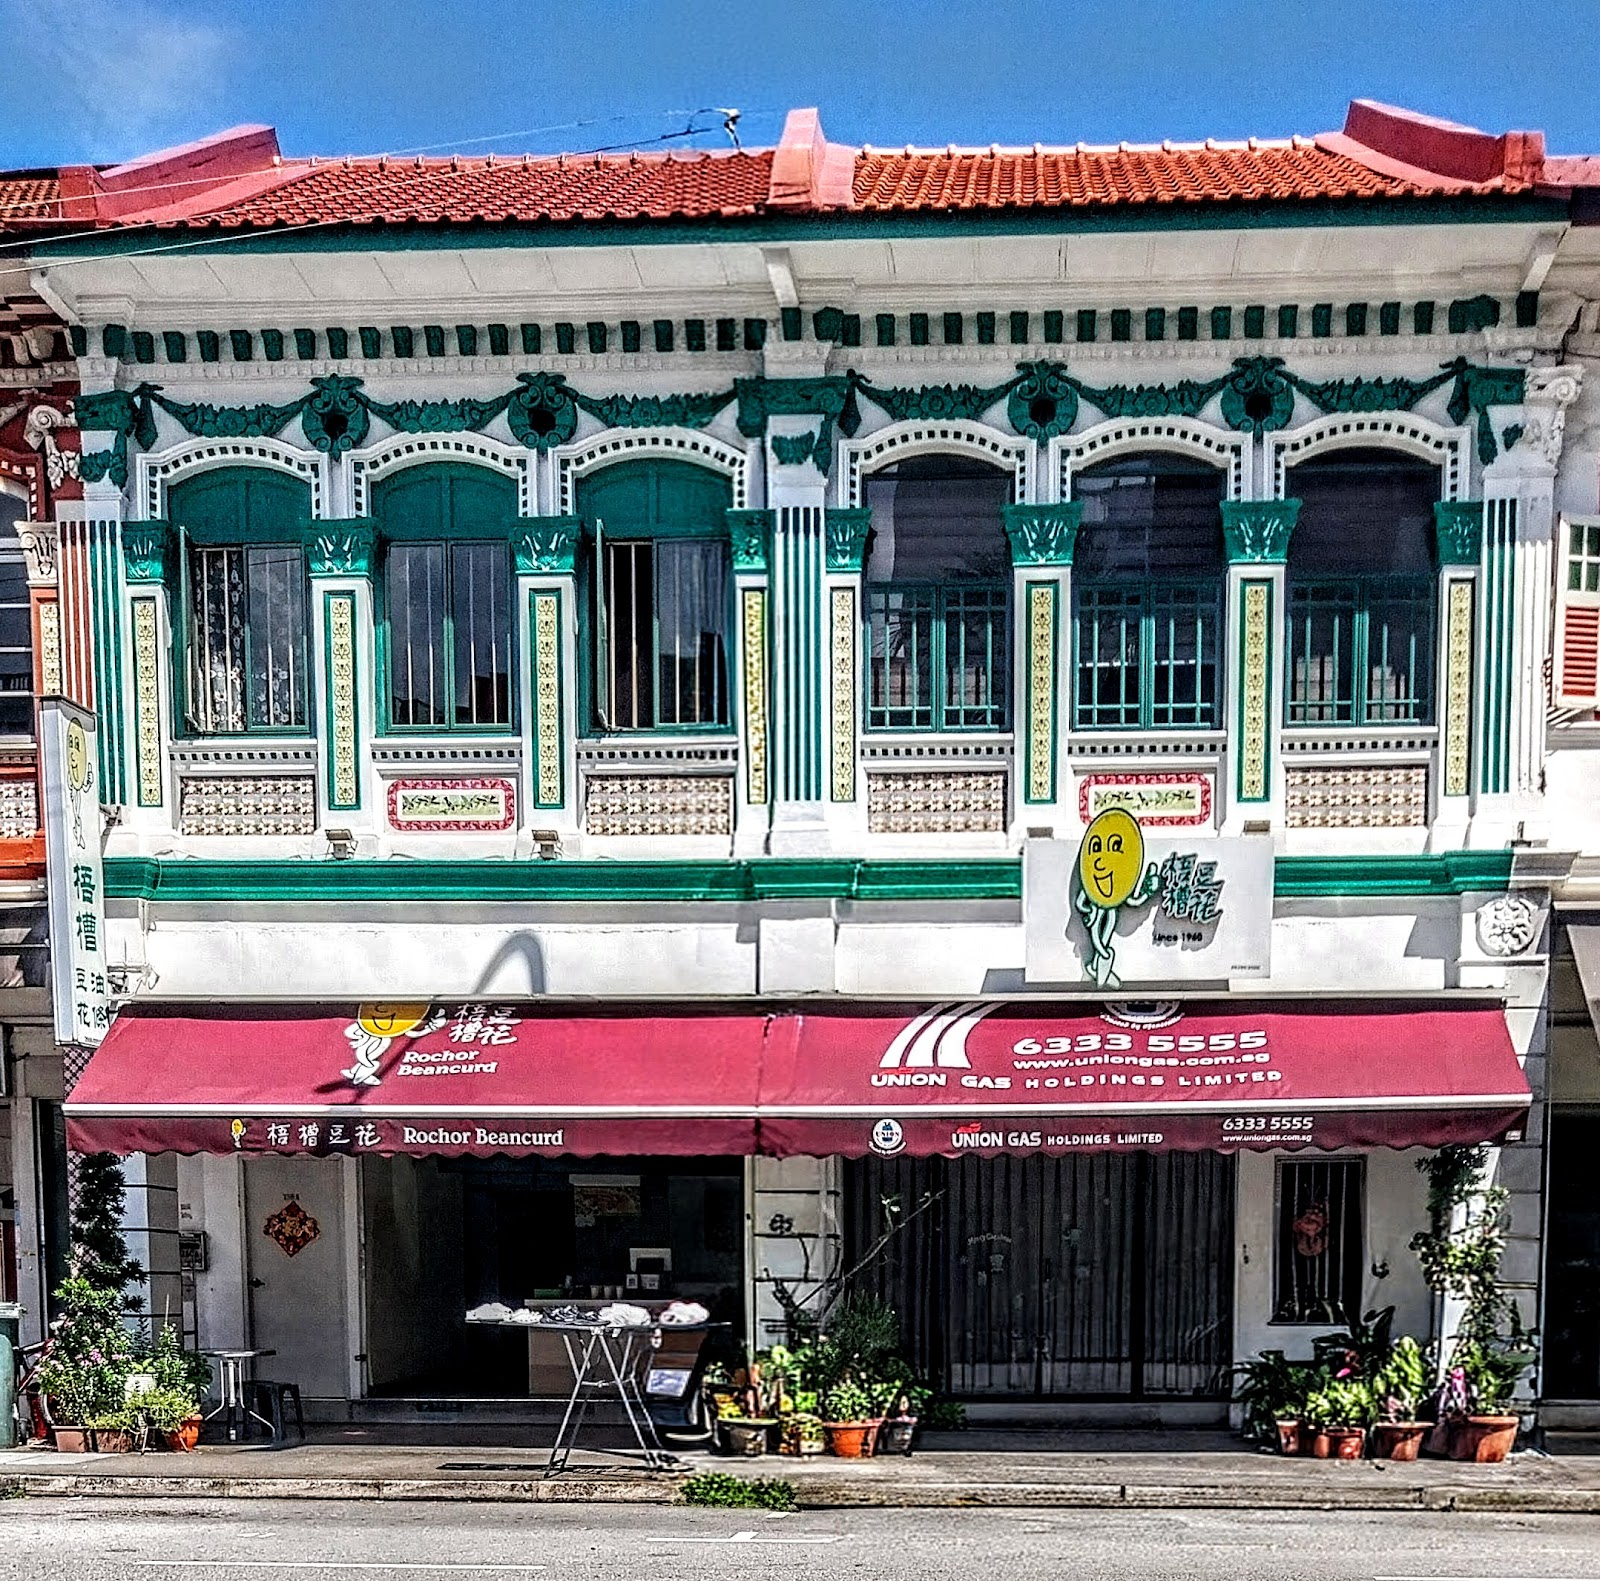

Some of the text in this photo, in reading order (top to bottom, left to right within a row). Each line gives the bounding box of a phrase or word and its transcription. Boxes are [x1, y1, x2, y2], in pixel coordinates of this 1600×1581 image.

[1013, 1031, 1268, 1055] 6333 5555
[402, 1050, 480, 1064] Rochor
[1013, 1053, 1270, 1069] www.uniongas.com.sg
[397, 1062, 498, 1077] Beancurd
[870, 1070, 1282, 1089] UNION GAS HOLDINGS LIMITED
[1222, 1116, 1314, 1131] 6333 5555
[403, 1126, 564, 1146] Rochor Beancurd
[951, 1131, 1164, 1148] UNION GAS HOLDINGS LIMITED
[1222, 1133, 1313, 1143] www.uniongas.com.sg
